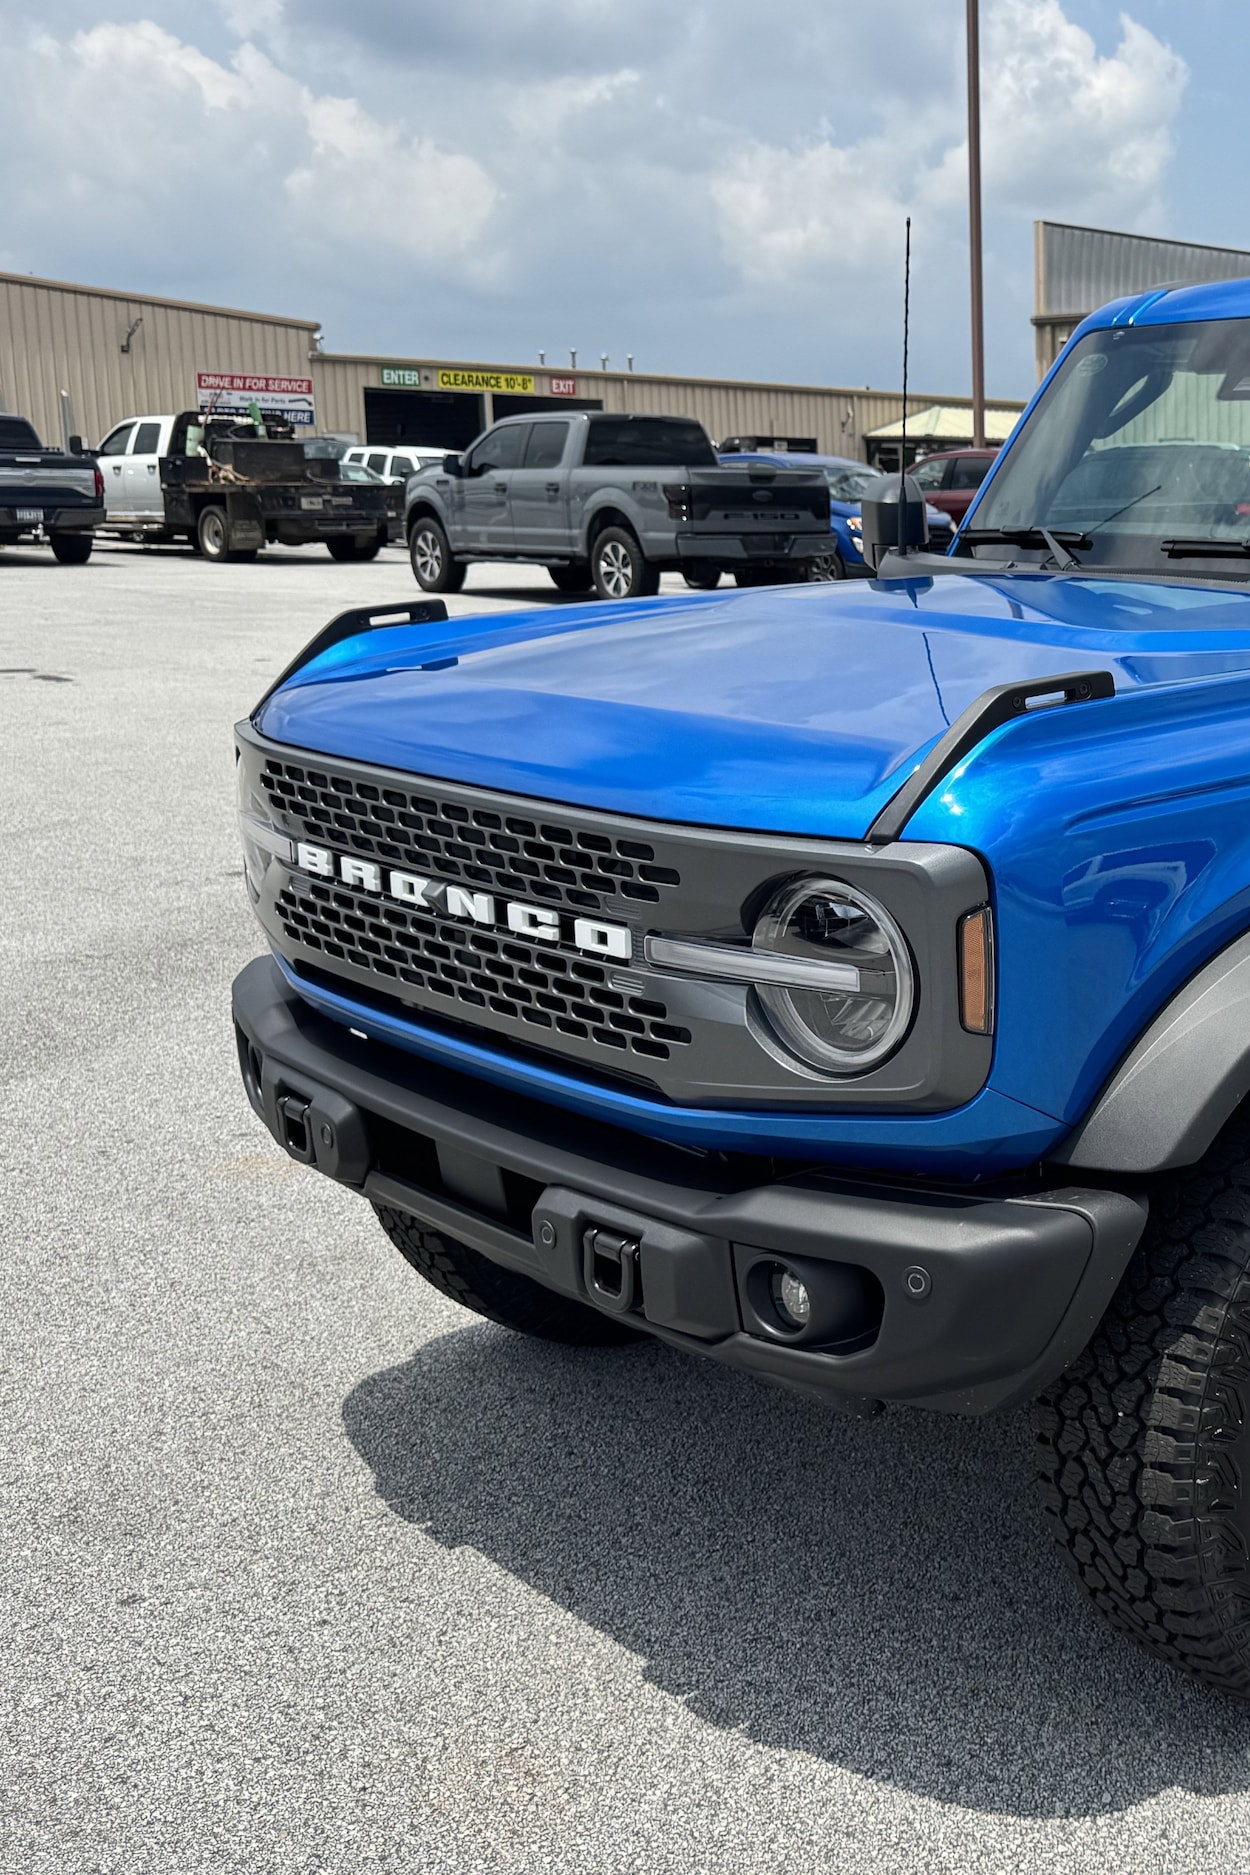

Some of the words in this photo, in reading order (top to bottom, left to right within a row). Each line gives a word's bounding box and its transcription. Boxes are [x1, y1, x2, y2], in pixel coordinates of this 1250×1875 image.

[201, 375, 232, 388] DRIVE
[233, 378, 244, 389] IN
[245, 379, 266, 391] FOR
[268, 380, 309, 393] SERVICE
[382, 369, 419, 384] ENTER
[441, 372, 502, 389] CLEARANCE
[552, 379, 575, 393] EXIT
[284, 410, 311, 423] HERE
[297, 841, 633, 960] BRONCO
